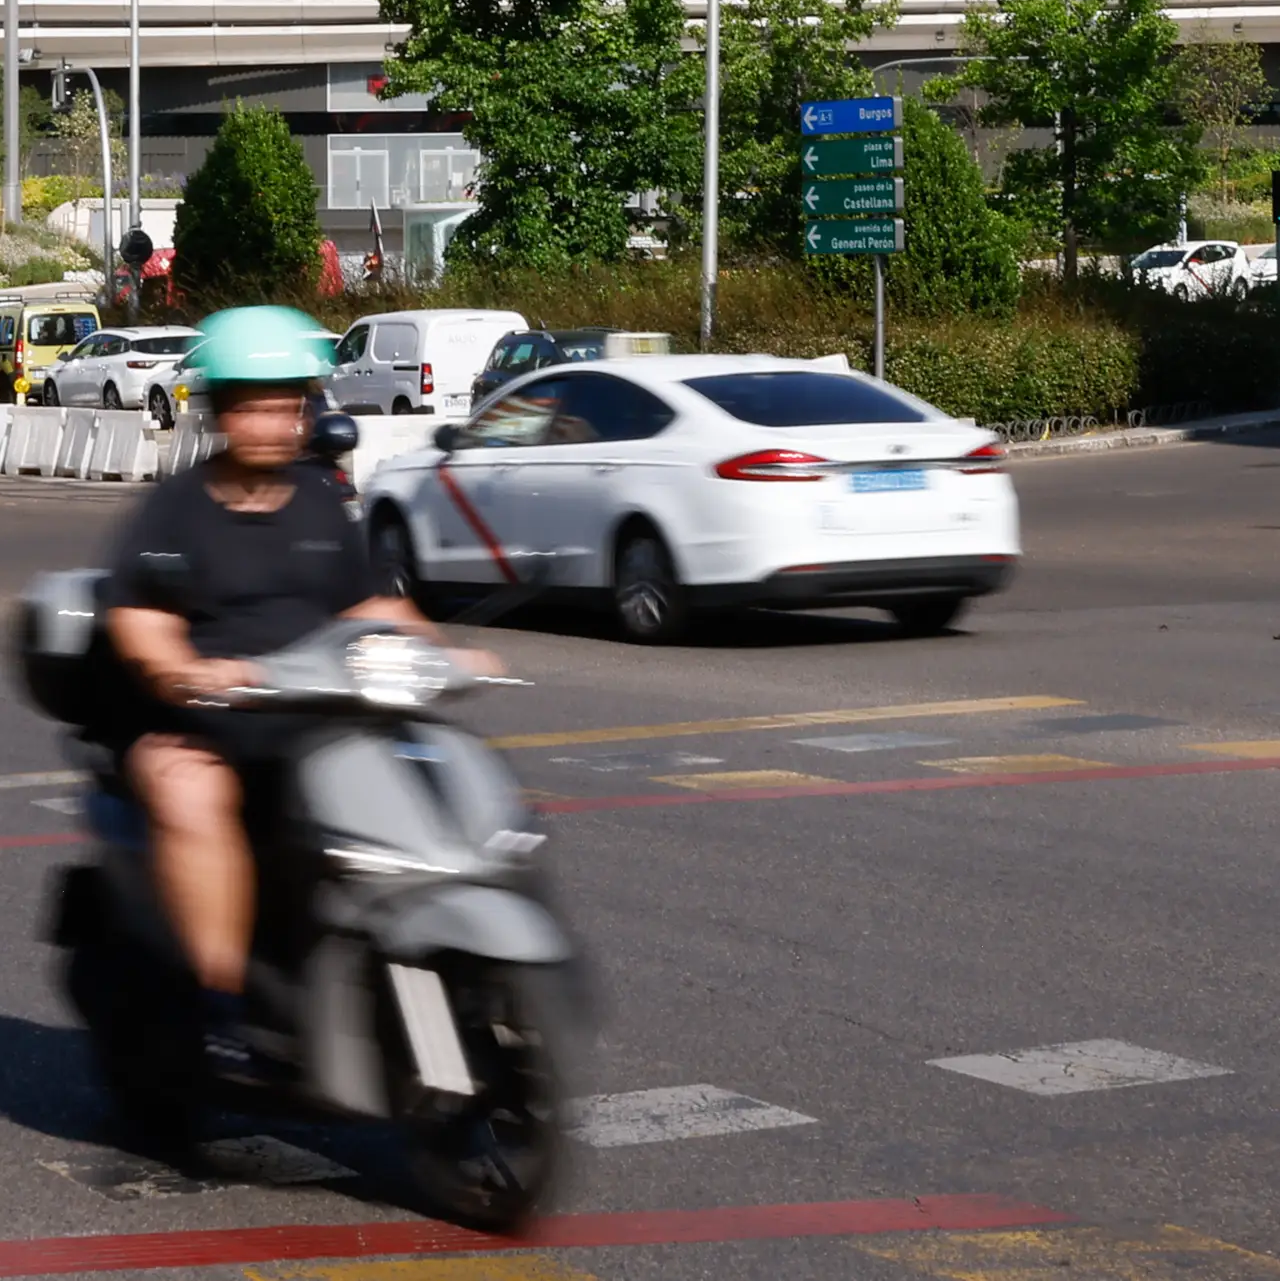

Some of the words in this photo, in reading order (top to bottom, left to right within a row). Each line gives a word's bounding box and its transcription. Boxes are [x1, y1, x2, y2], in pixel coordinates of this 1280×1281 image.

[821, 111, 832, 122] A-1
[859, 107, 892, 121] Burgos
[863, 142, 882, 152] plaza
[883, 141, 893, 150] de
[870, 155, 893, 168] Lima
[853, 183, 875, 193] paseo
[876, 182, 885, 191] de
[886, 181, 893, 191] la
[843, 196, 894, 209] Castellana
[854, 224, 881, 233] avenida
[882, 223, 893, 233] del
[831, 236, 867, 249] General
[868, 236, 894, 249] Perón
